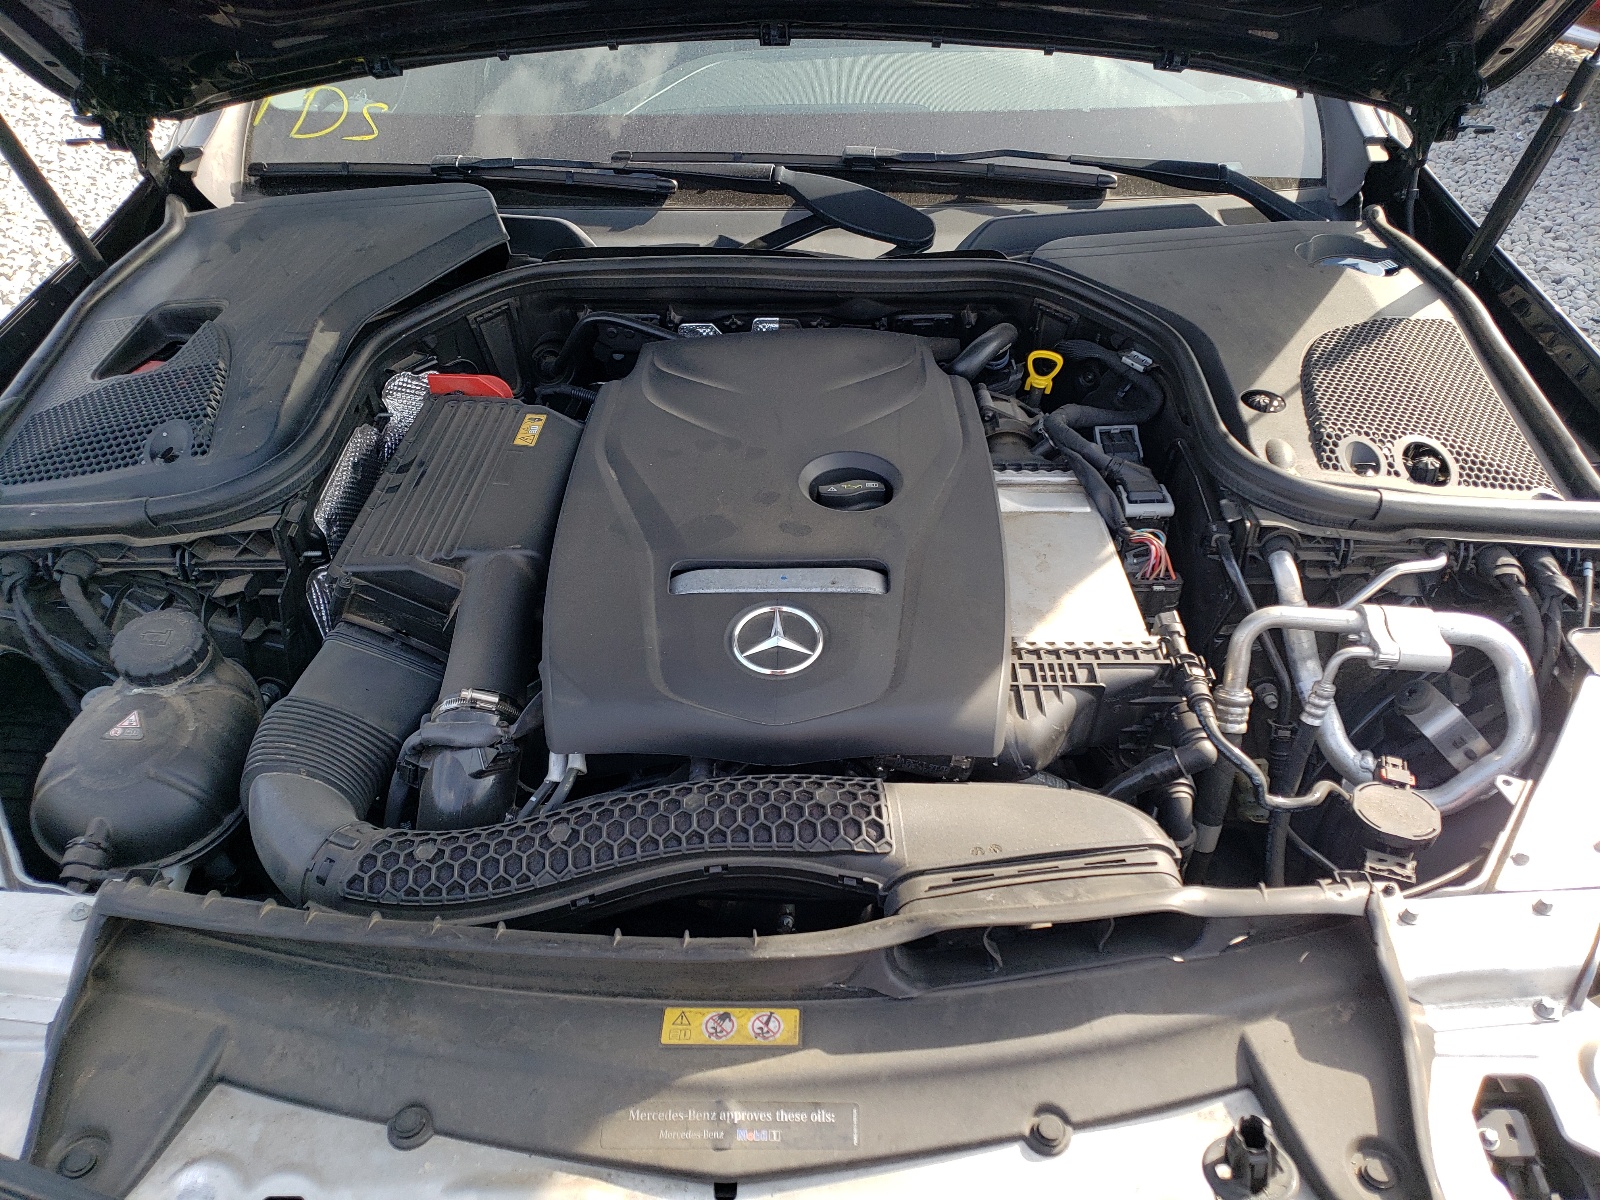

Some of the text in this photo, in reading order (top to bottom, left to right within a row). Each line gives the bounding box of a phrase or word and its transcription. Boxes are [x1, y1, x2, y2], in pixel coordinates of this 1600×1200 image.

[629, 1108, 836, 1124] Mercedes-Benz approves these oils:
[659, 1129, 725, 1140] Mercedes-Benz
[736, 1128, 768, 1141] Mobil
